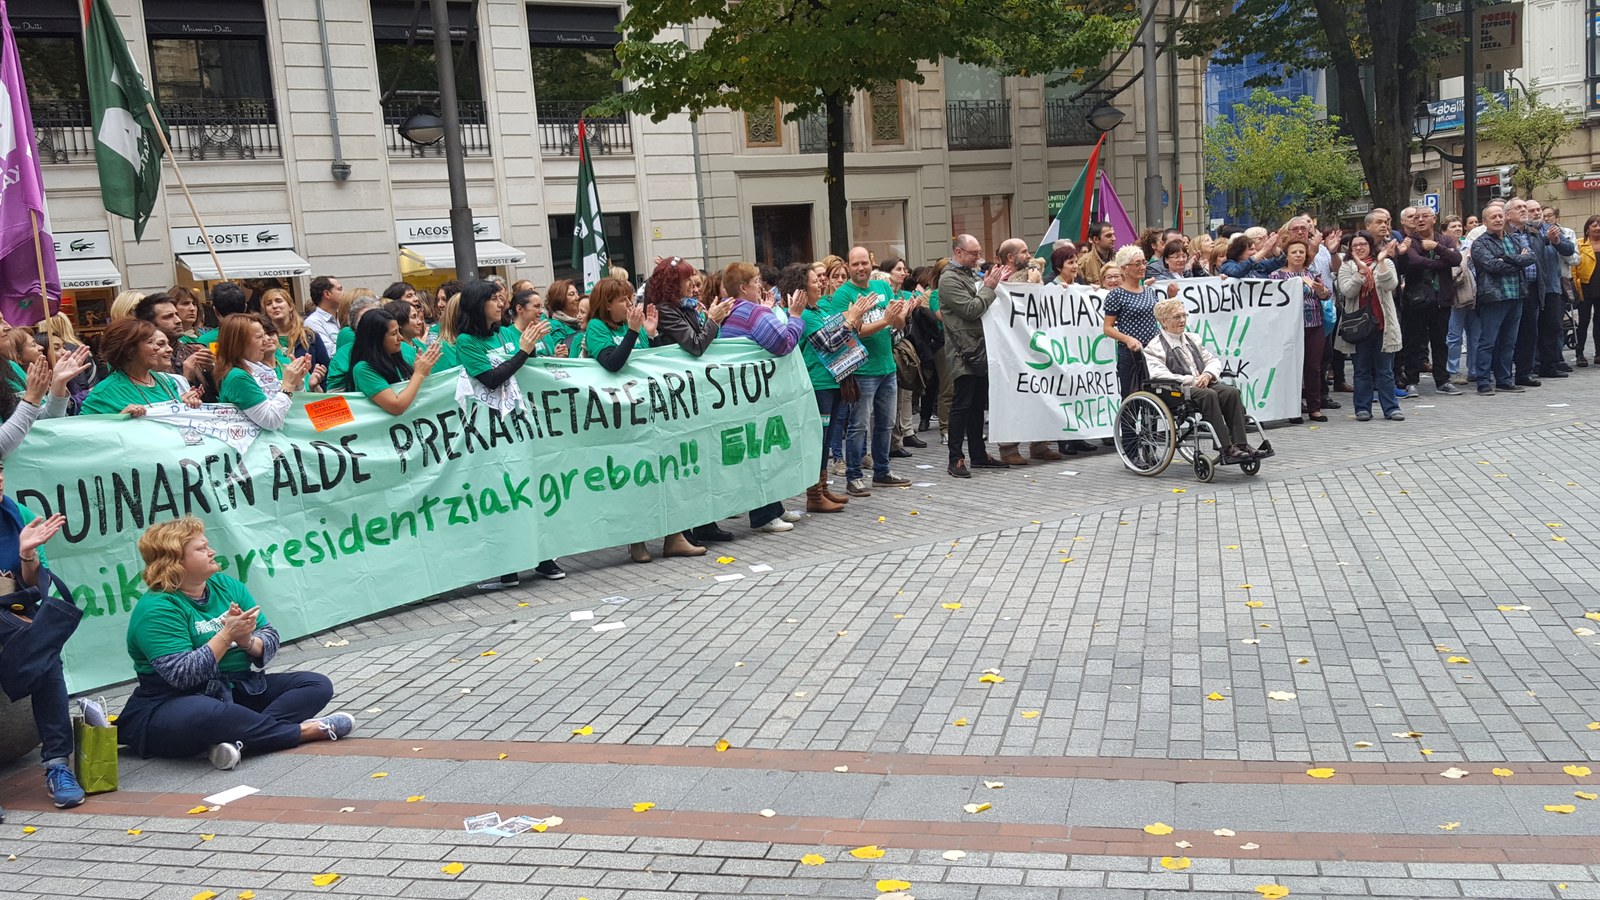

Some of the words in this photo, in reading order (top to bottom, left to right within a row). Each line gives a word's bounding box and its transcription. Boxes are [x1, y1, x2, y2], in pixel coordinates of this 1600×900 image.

[187, 233, 249, 246] LACOSTE
[409, 226, 451, 236] LACOS
[63, 280, 99, 288] LACOSTE
[1009, 291, 1105, 328] FAMILIAR
[269, 433, 371, 500] ALDE
[390, 370, 699, 474] PREKARIETATEARI
[705, 359, 776, 410] STOP
[721, 416, 791, 466] ELA
